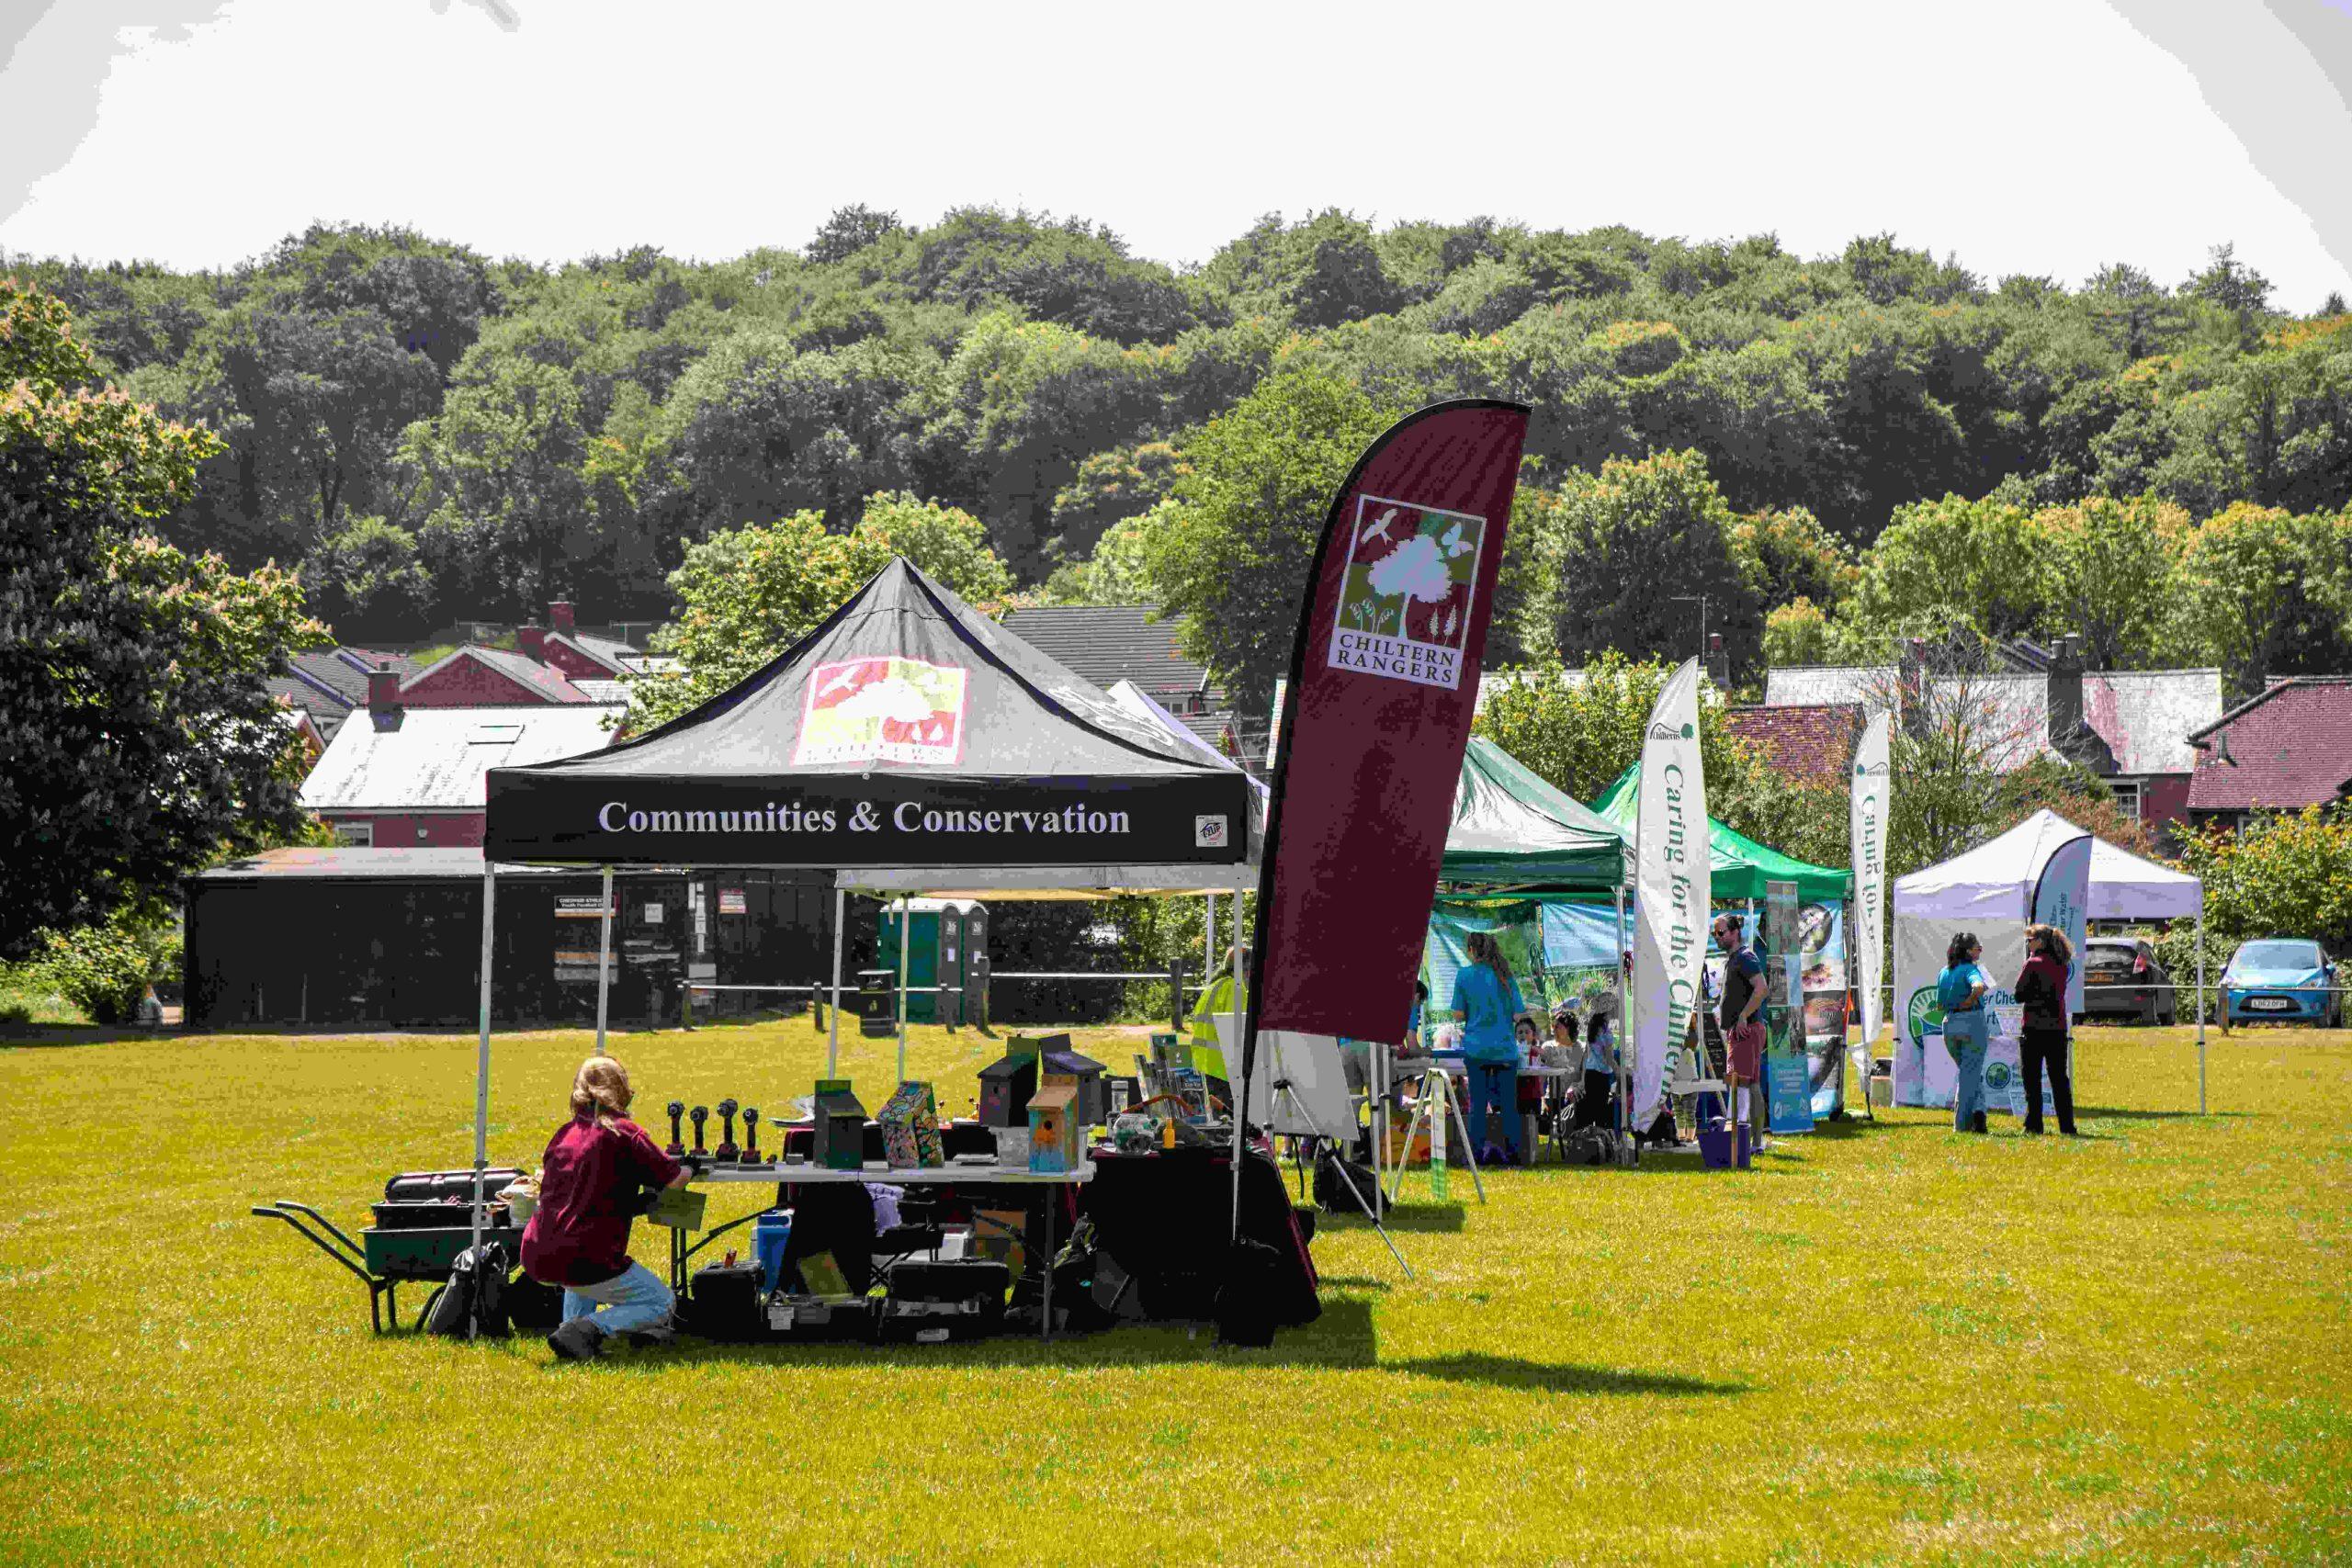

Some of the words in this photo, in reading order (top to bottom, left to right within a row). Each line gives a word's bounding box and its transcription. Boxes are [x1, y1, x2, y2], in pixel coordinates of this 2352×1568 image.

[1337, 650, 1452, 682] RANGERS
[1340, 634, 1455, 667] CHILTERN
[598, 802, 837, 833] Communities
[848, 801, 881, 832] &
[893, 802, 1131, 834] Conservation
[1664, 764, 1686, 865] Caring
[1671, 872, 1691, 917] for
[1669, 924, 1694, 969] the
